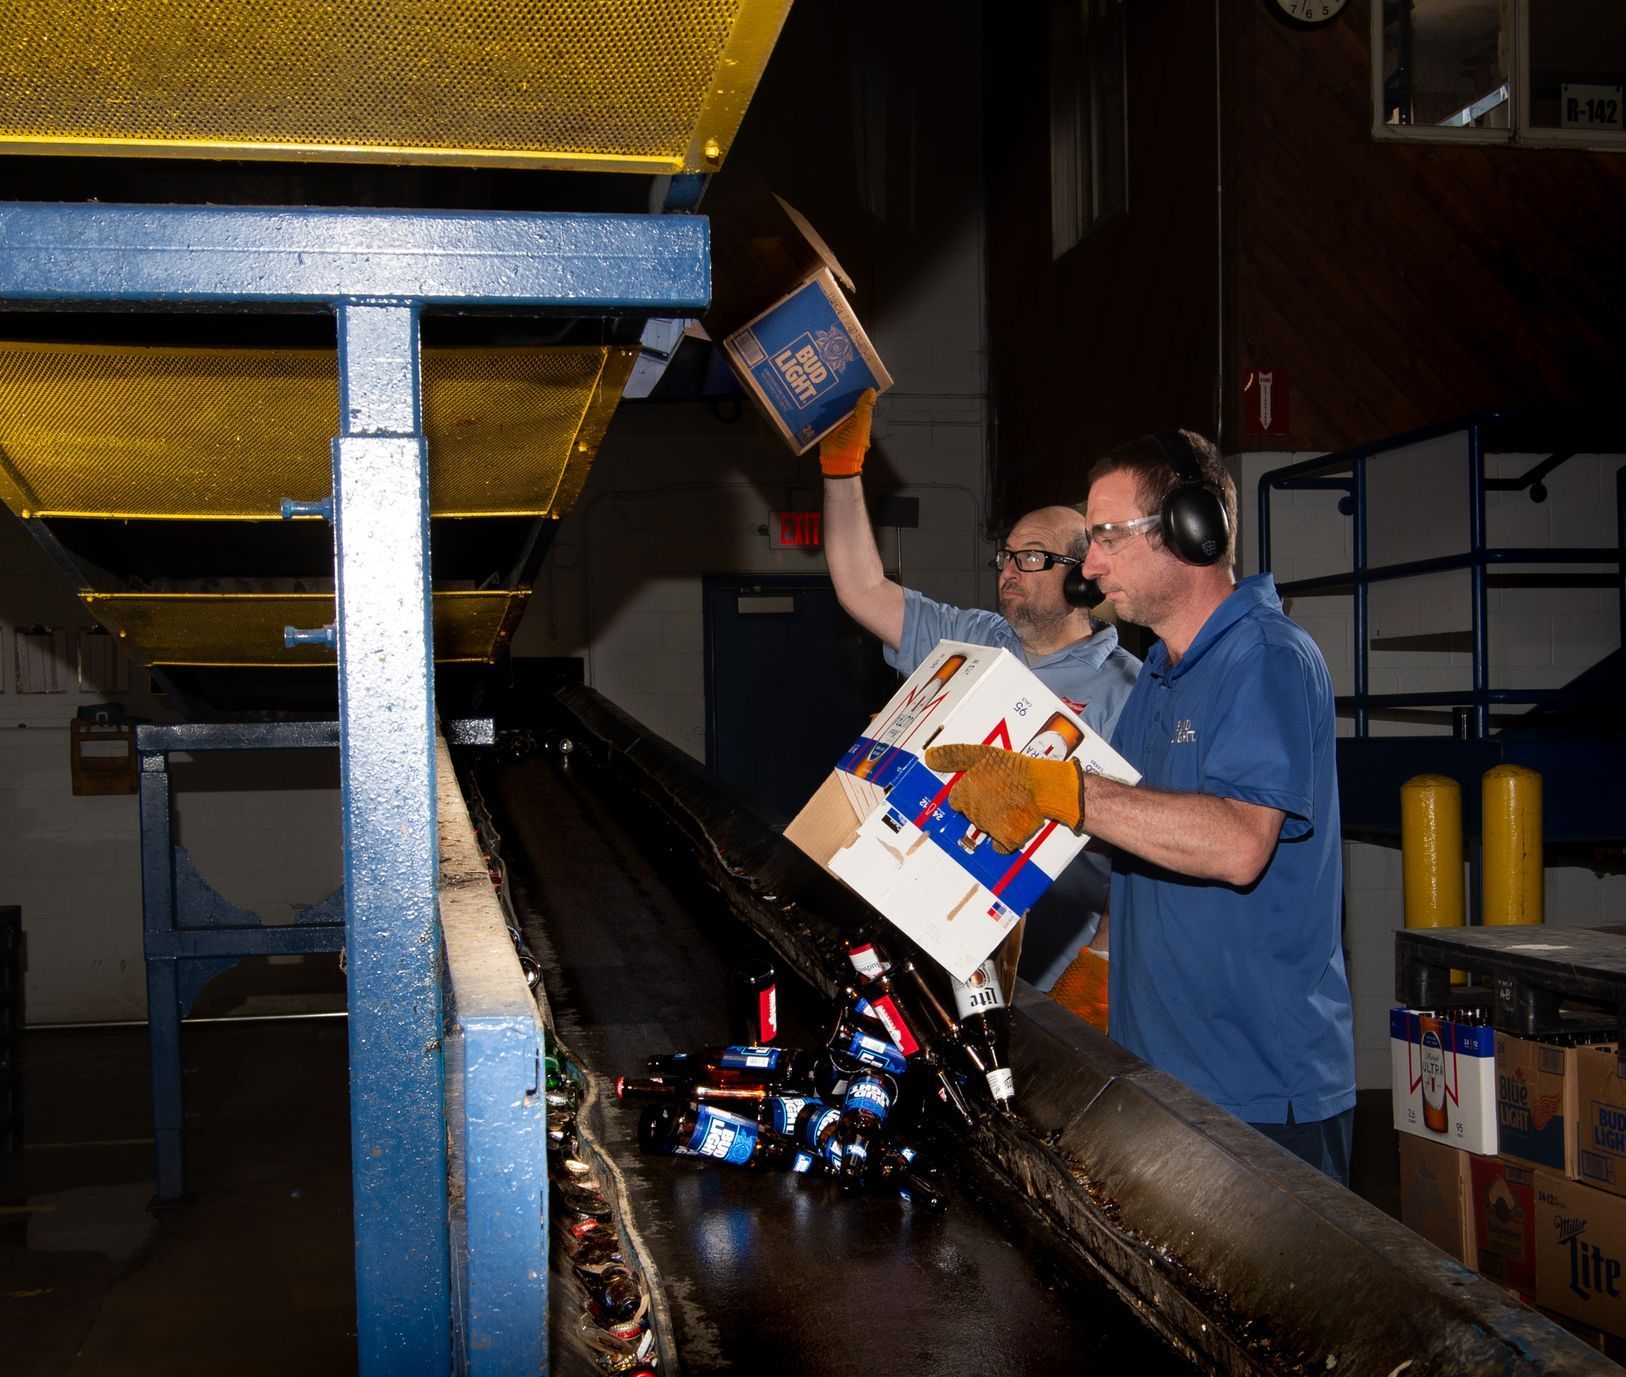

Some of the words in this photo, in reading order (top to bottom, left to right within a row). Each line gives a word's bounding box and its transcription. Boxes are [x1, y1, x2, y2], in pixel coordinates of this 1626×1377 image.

[1305, 8, 1313, 19] 6
[1322, 5, 1330, 16] 5
[1567, 98, 1618, 124] R-142
[775, 350, 817, 401] LIGHT
[795, 344, 828, 385] BUD
[781, 511, 821, 545] EXIT
[1013, 701, 1028, 717] 95
[919, 799, 929, 809] 12
[970, 987, 998, 1008] Lite
[1499, 1074, 1529, 1106] Blue
[1456, 1122, 1464, 1133] 95
[1499, 1104, 1530, 1133] LIGHT
[1599, 1108, 1626, 1132] BUD
[712, 1128, 734, 1159] BUD
[1594, 1126, 1626, 1152] LIGH
[1553, 1214, 1588, 1239] Miller
[1557, 1236, 1621, 1301] Lite
